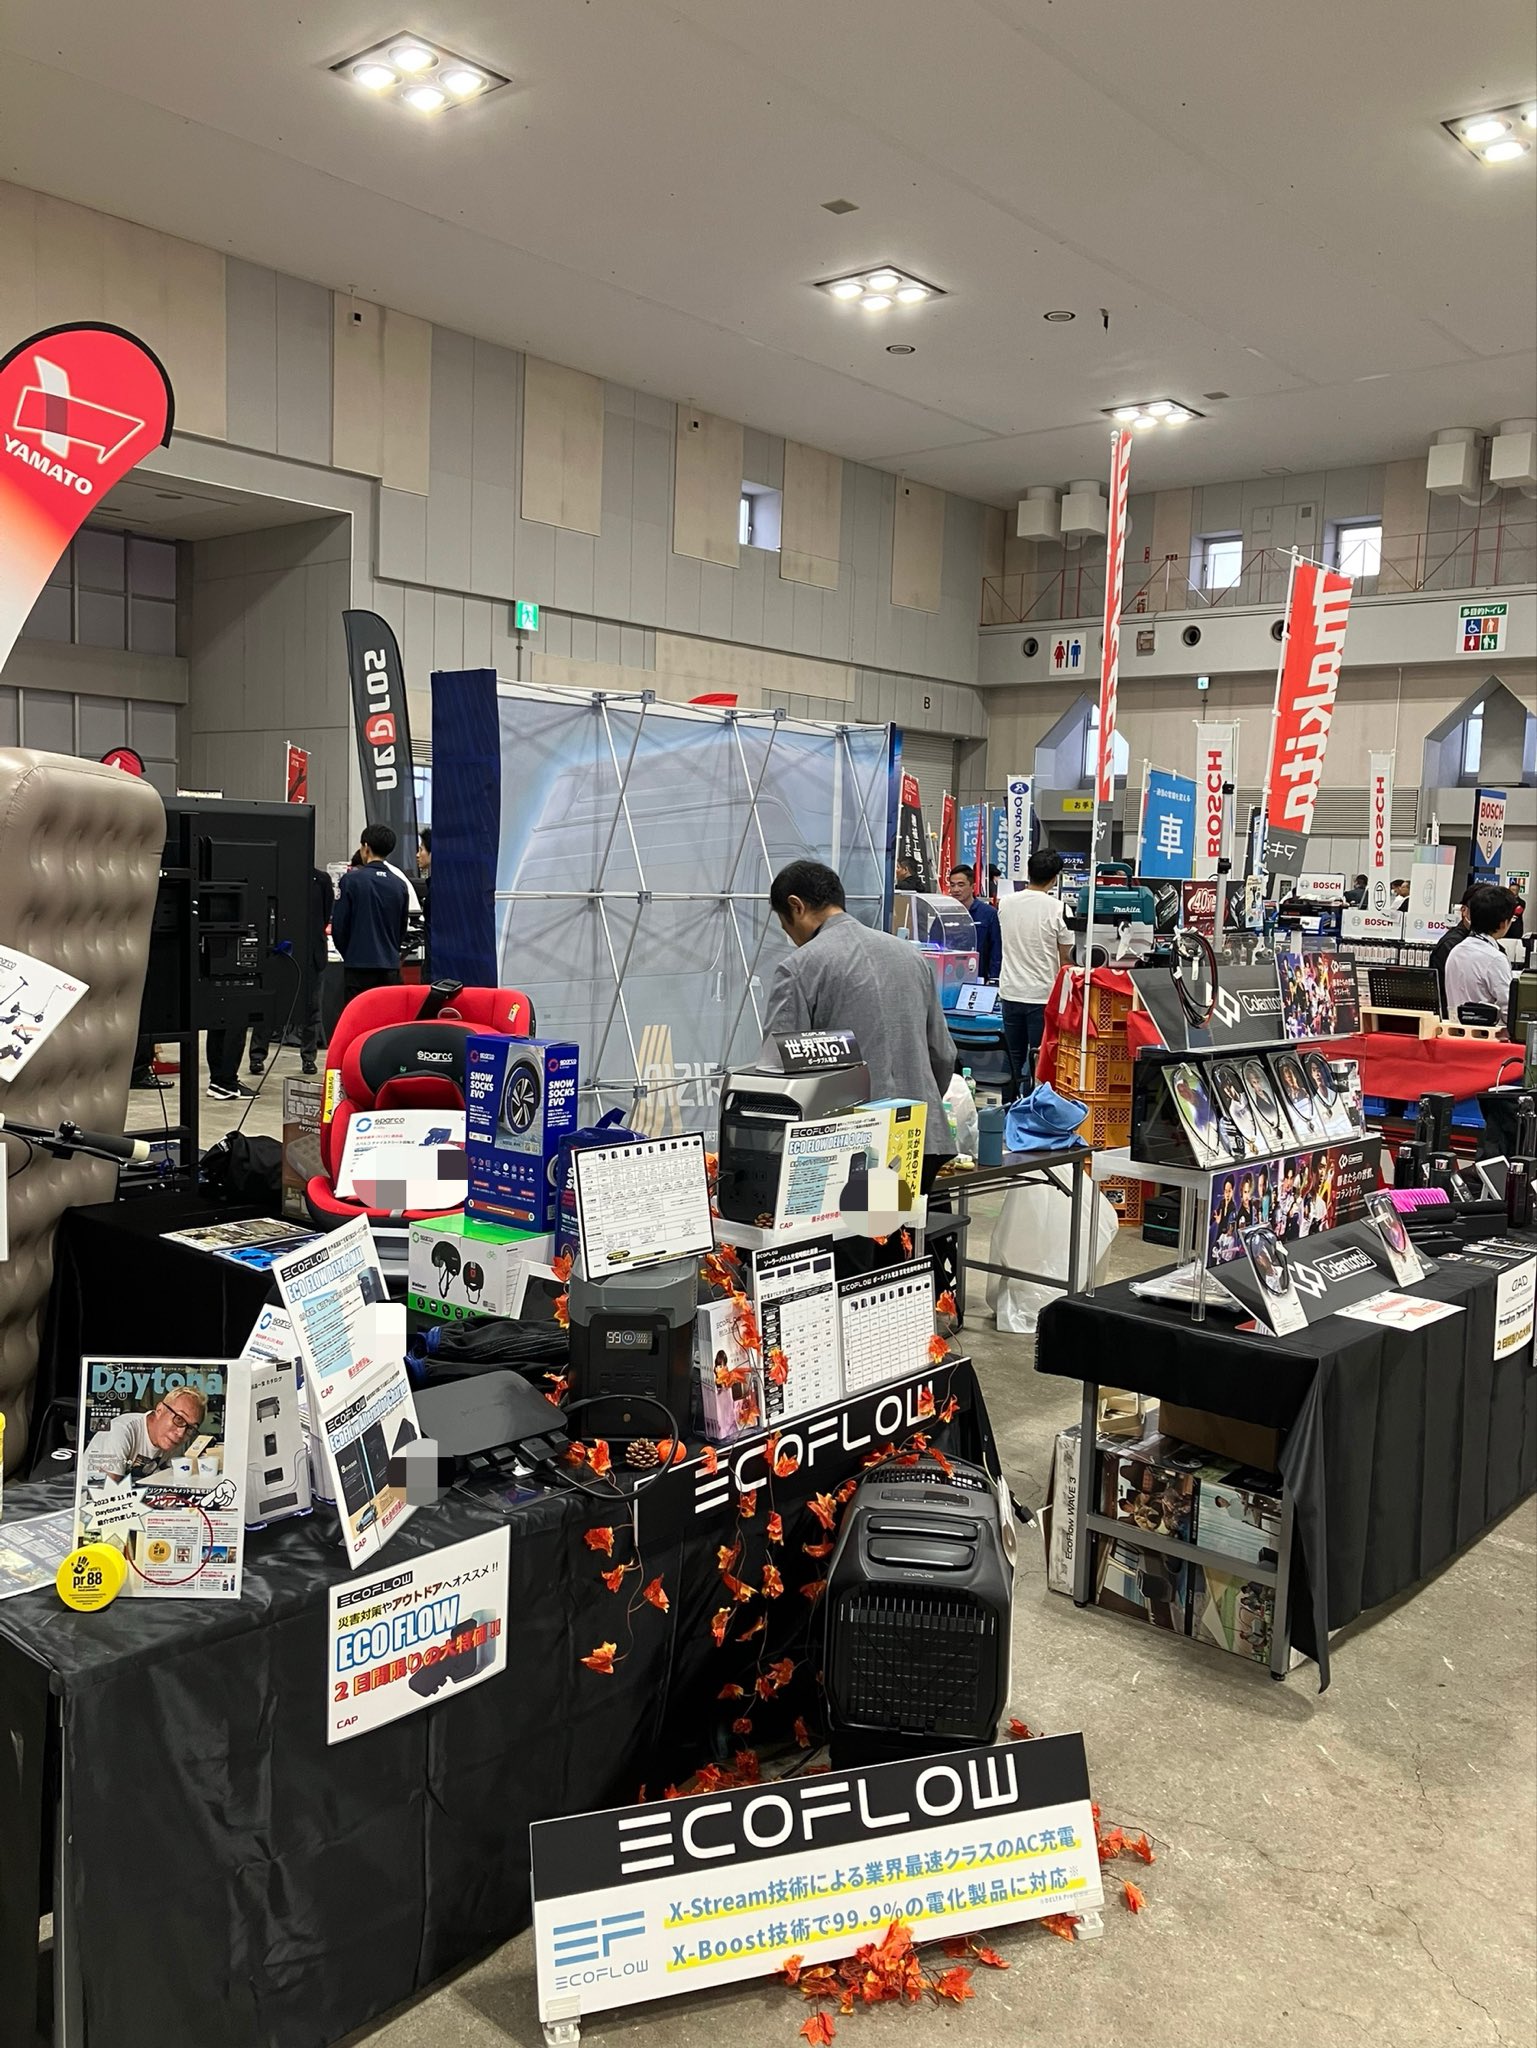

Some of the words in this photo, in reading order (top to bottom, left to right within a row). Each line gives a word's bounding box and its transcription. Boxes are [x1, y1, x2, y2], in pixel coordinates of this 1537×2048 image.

[3, 433, 93, 496] YAMATO
[1463, 607, 1504, 616] 多目的トイレ
[922, 696, 931, 710] B
[1480, 802, 1504, 820] BOSCH
[1157, 813, 1184, 859] 車
[1478, 823, 1502, 839] Service
[1313, 881, 1341, 890] BOSCH
[1364, 918, 1393, 927] BOSCH
[1428, 921, 1450, 929] BOS
[62, 982, 78, 993] CAP
[784, 1035, 851, 1059] 世界No.1
[470, 1071, 494, 1083] SNOW
[548, 1079, 575, 1090] SNOW
[470, 1080, 494, 1092] SOCKS
[548, 1087, 575, 1098] SOCKS
[470, 1089, 485, 1099] EVO
[287, 1100, 322, 1118] 電動エア
[548, 1097, 565, 1107] EVO
[374, 1117, 405, 1125] sparco
[792, 1124, 836, 1138] ECOFLOW
[788, 1140, 806, 1156] ECO
[807, 1136, 828, 1154] FLOW
[828, 1134, 849, 1150] DELTA
[849, 1133, 856, 1148] 3
[856, 1132, 872, 1147] Plus
[779, 1221, 793, 1230] CAP
[756, 1250, 779, 1260] ECOFLOW
[283, 1248, 329, 1280] ECOFLOW
[1319, 1250, 1369, 1279] Colantotte
[286, 1279, 307, 1304] ECO
[306, 1267, 329, 1297] FLOW
[841, 1279, 871, 1293] ECOFLOW
[607, 1331, 621, 1344] 99
[91, 1364, 224, 1400] Daytona
[321, 1385, 334, 1399] CAP
[327, 1396, 367, 1433] ECOFLOW
[694, 1381, 935, 1514] ECOFLOW
[1067, 1484, 1075, 1516] WAVE
[95, 1502, 134, 1517] Daytonaにて
[97, 1511, 141, 1527] 紹介されました。
[353, 1538, 367, 1552] CAP
[1065, 1517, 1074, 1561] EcoFlow
[73, 1575, 86, 1589] pr
[87, 1571, 103, 1585] 88
[339, 1572, 412, 1607] ECOFLOW
[337, 1623, 389, 1672] ECO
[393, 1594, 460, 1652] FLOW
[336, 1715, 359, 1729] CAP
[619, 1753, 1018, 1875] ECOFLOW
[669, 1826, 1077, 1923] X-Stream技術による業界最速クラスのAC充電
[556, 1959, 649, 1990] ECOFLOW
